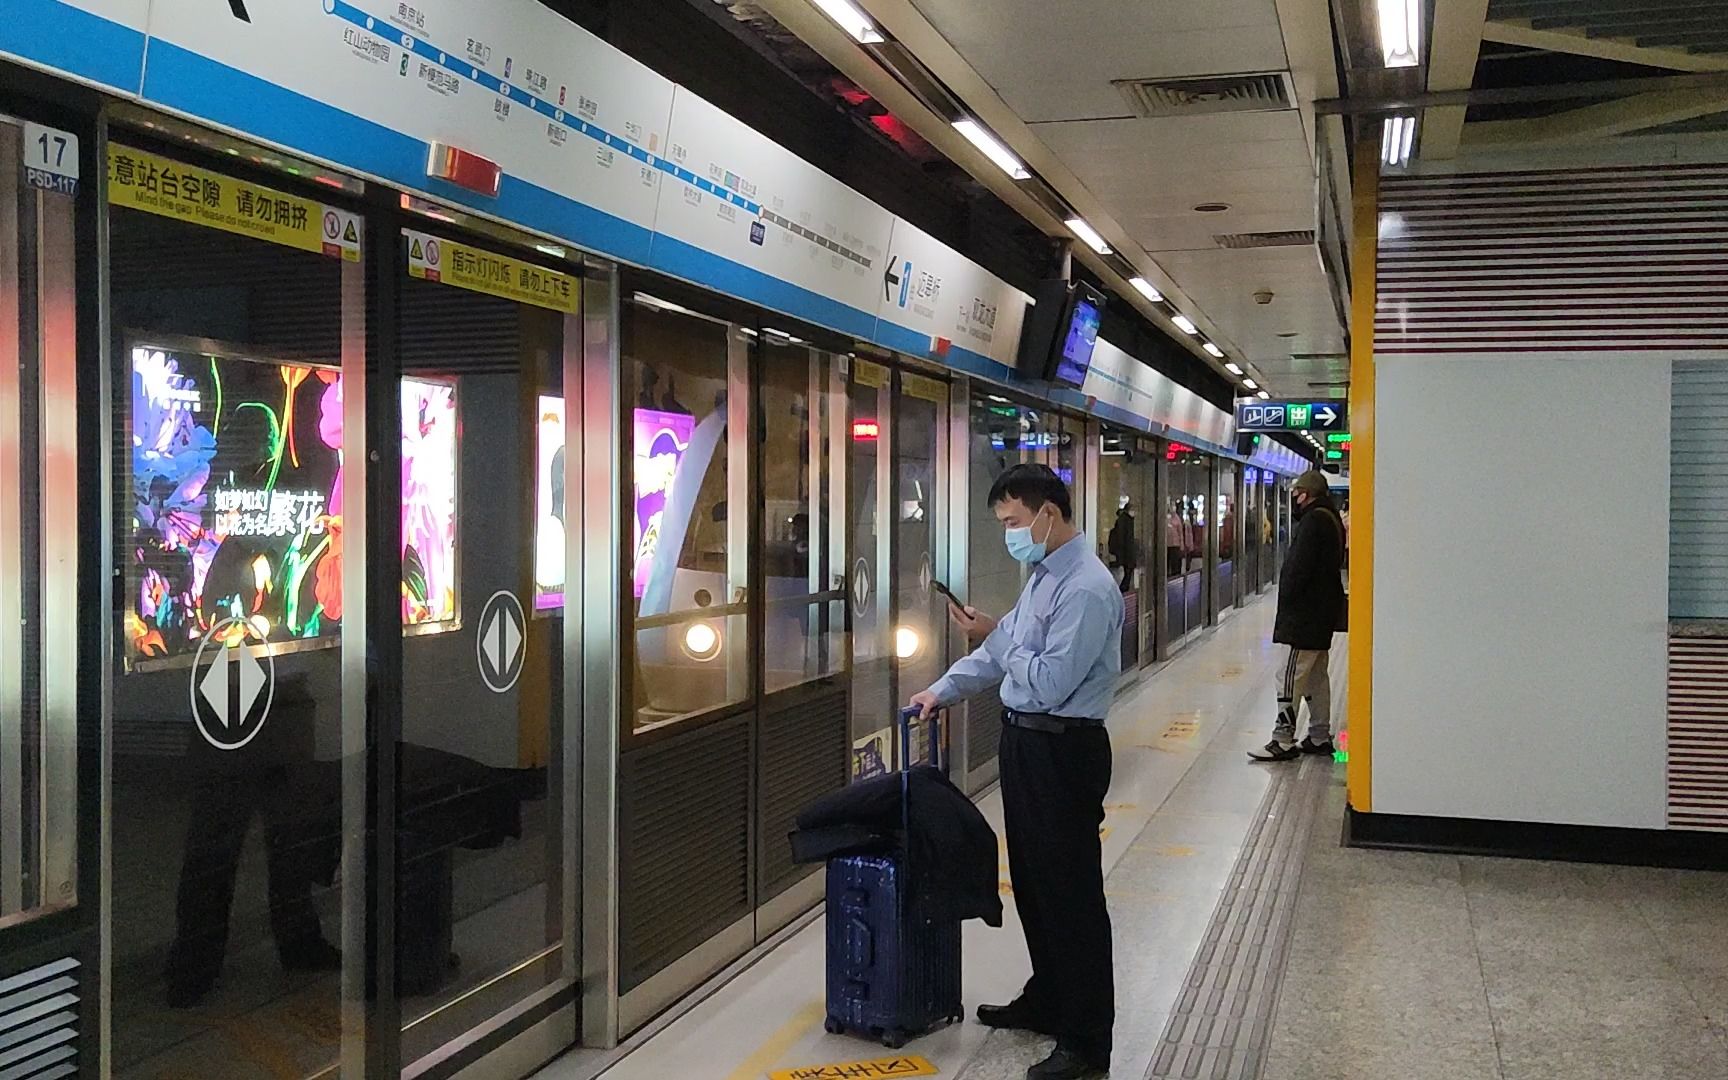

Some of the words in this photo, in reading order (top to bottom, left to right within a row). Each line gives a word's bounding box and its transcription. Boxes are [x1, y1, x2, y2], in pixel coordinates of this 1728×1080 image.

[38, 133, 67, 167] 17
[27, 169, 76, 194] PSD-117
[135, 191, 158, 205] Mind
[160, 198, 174, 210] the
[195, 206, 225, 222] Please
[236, 188, 308, 231] 请勿拥挤
[452, 249, 512, 284] 指示灯闪烁
[519, 268, 571, 298] 请勿上下车
[267, 489, 325, 537] 繁花
